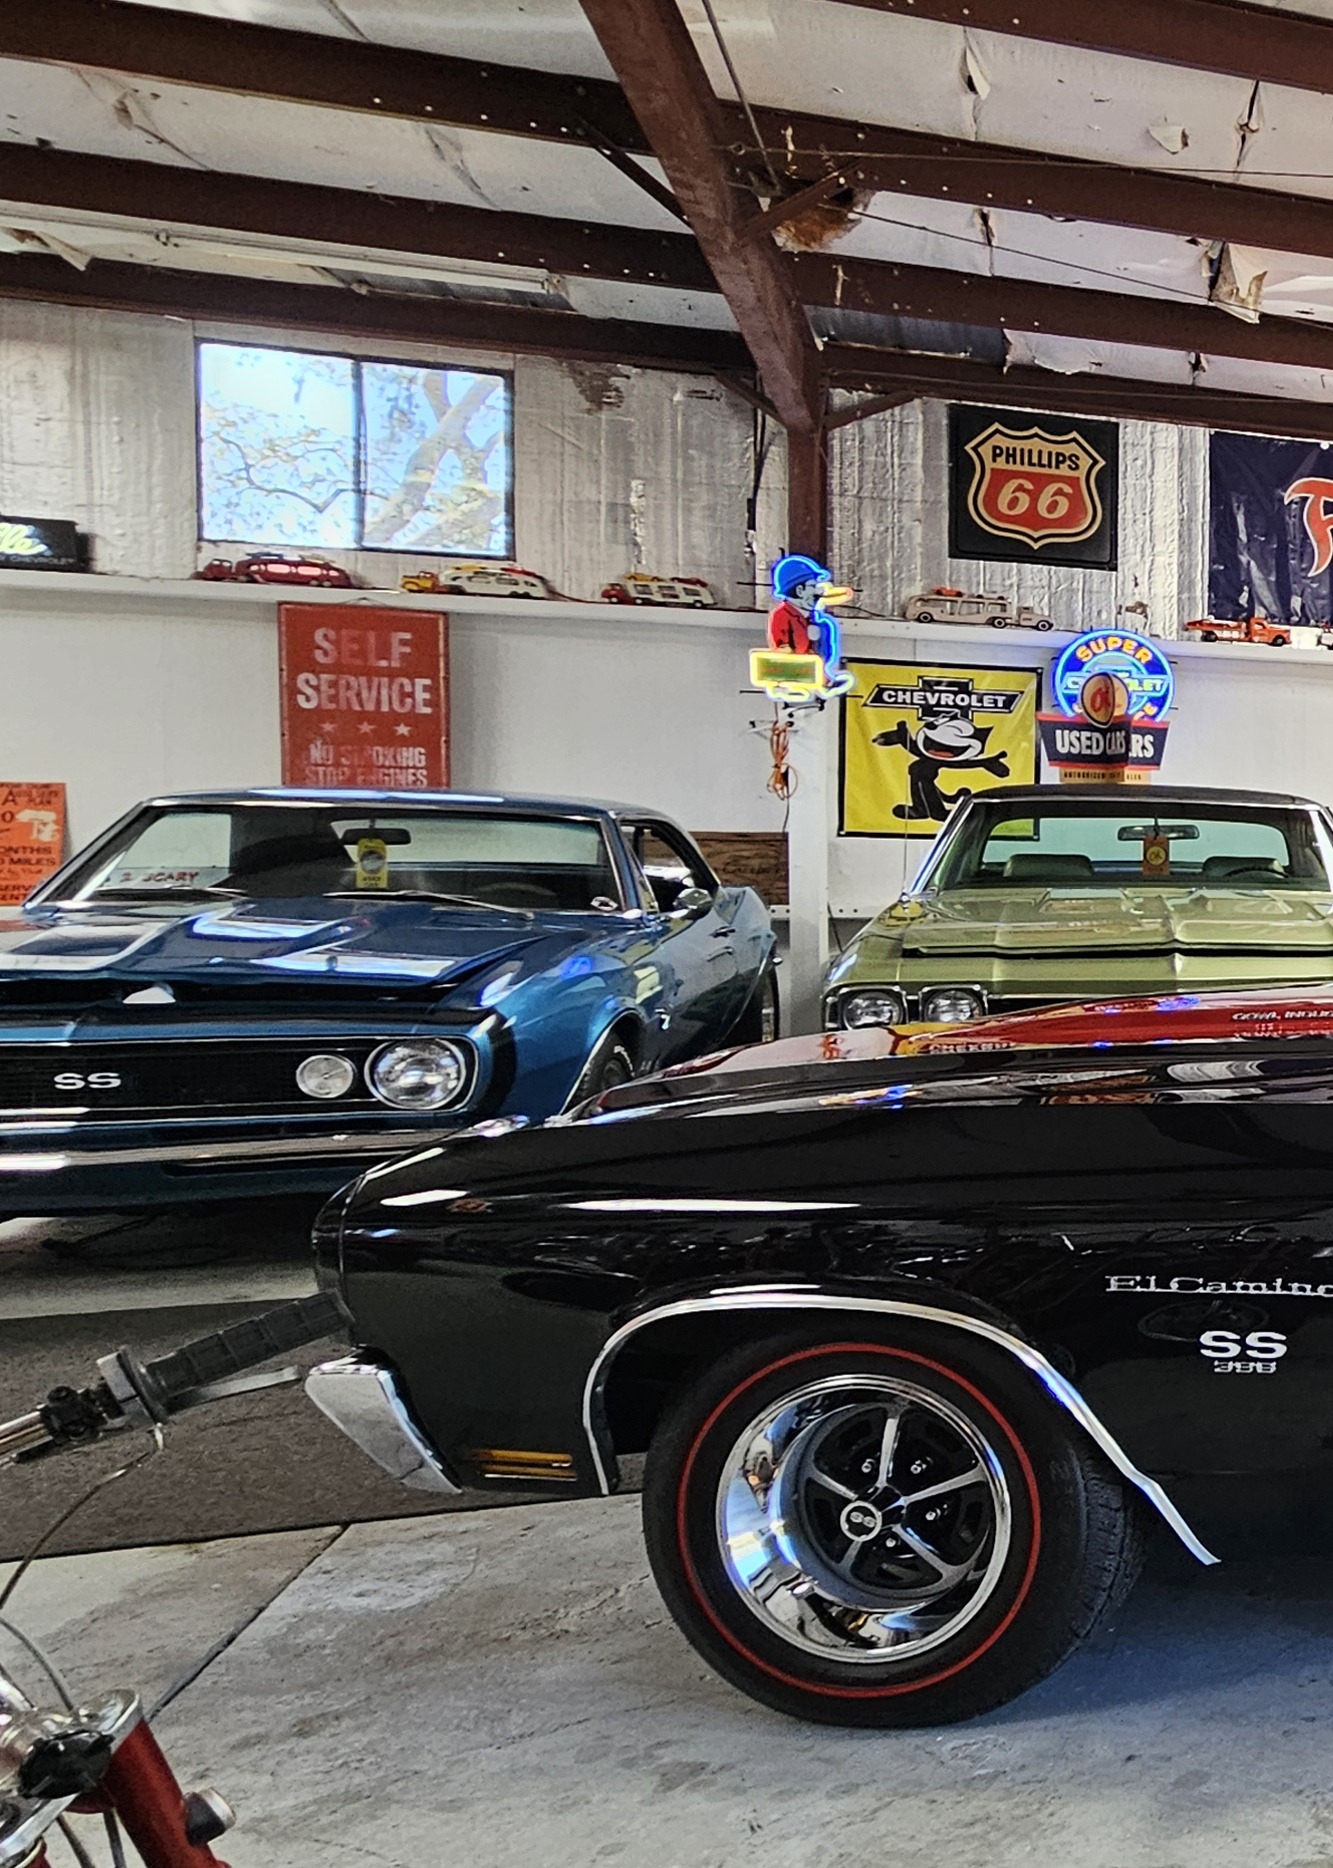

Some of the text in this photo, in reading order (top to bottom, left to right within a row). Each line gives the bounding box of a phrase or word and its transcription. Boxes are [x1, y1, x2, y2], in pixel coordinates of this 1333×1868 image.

[991, 445, 1080, 471] PHILLIPS
[997, 478, 1073, 520] 66
[313, 627, 412, 668] SELF
[1076, 636, 1153, 664] SUPER
[296, 672, 432, 714] SERVICE
[882, 689, 1007, 708] CHEVROLET
[309, 743, 333, 766] NO
[1055, 729, 1126, 755] USED CARS
[53, 1072, 122, 1090] SS
[1199, 1330, 1288, 1358] SS
[849, 1511, 877, 1528] SS
